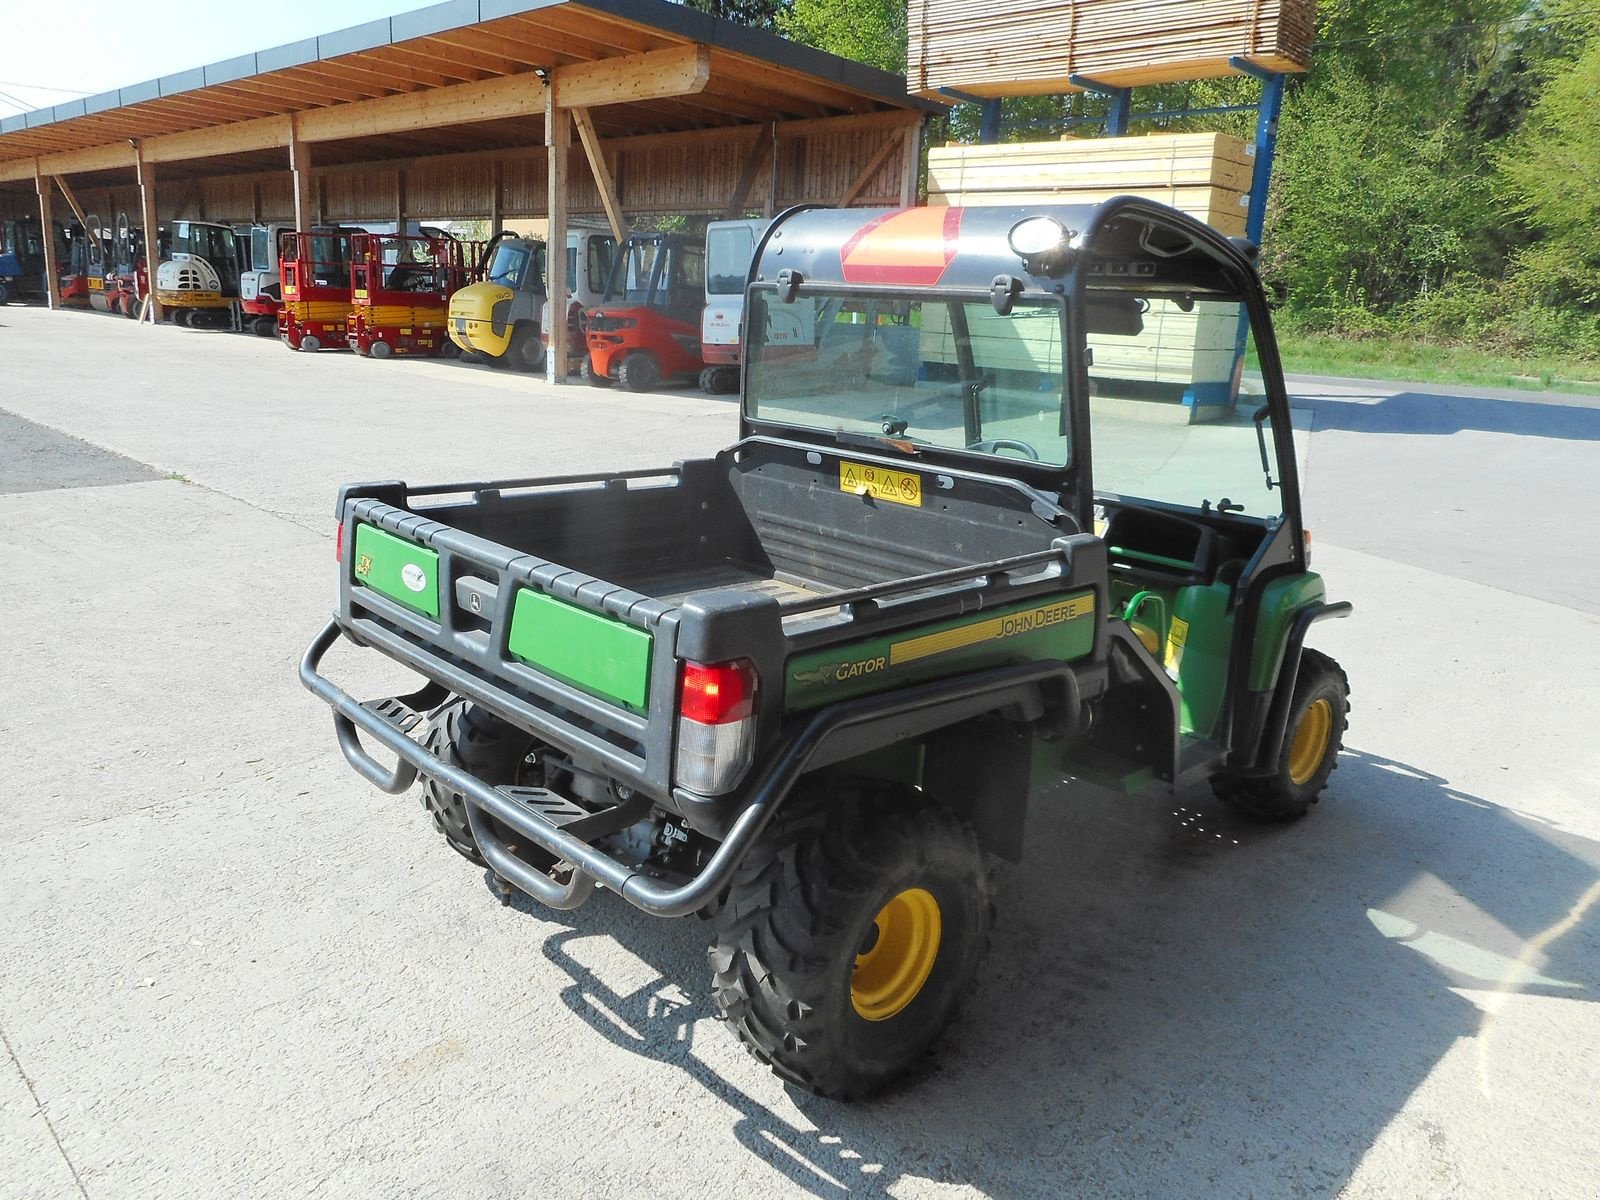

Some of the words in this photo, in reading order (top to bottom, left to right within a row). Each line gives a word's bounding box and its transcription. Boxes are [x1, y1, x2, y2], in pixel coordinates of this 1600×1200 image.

[996, 615, 1033, 637] JOHN
[1035, 604, 1077, 627] DEERE
[835, 656, 886, 681] GATOR
